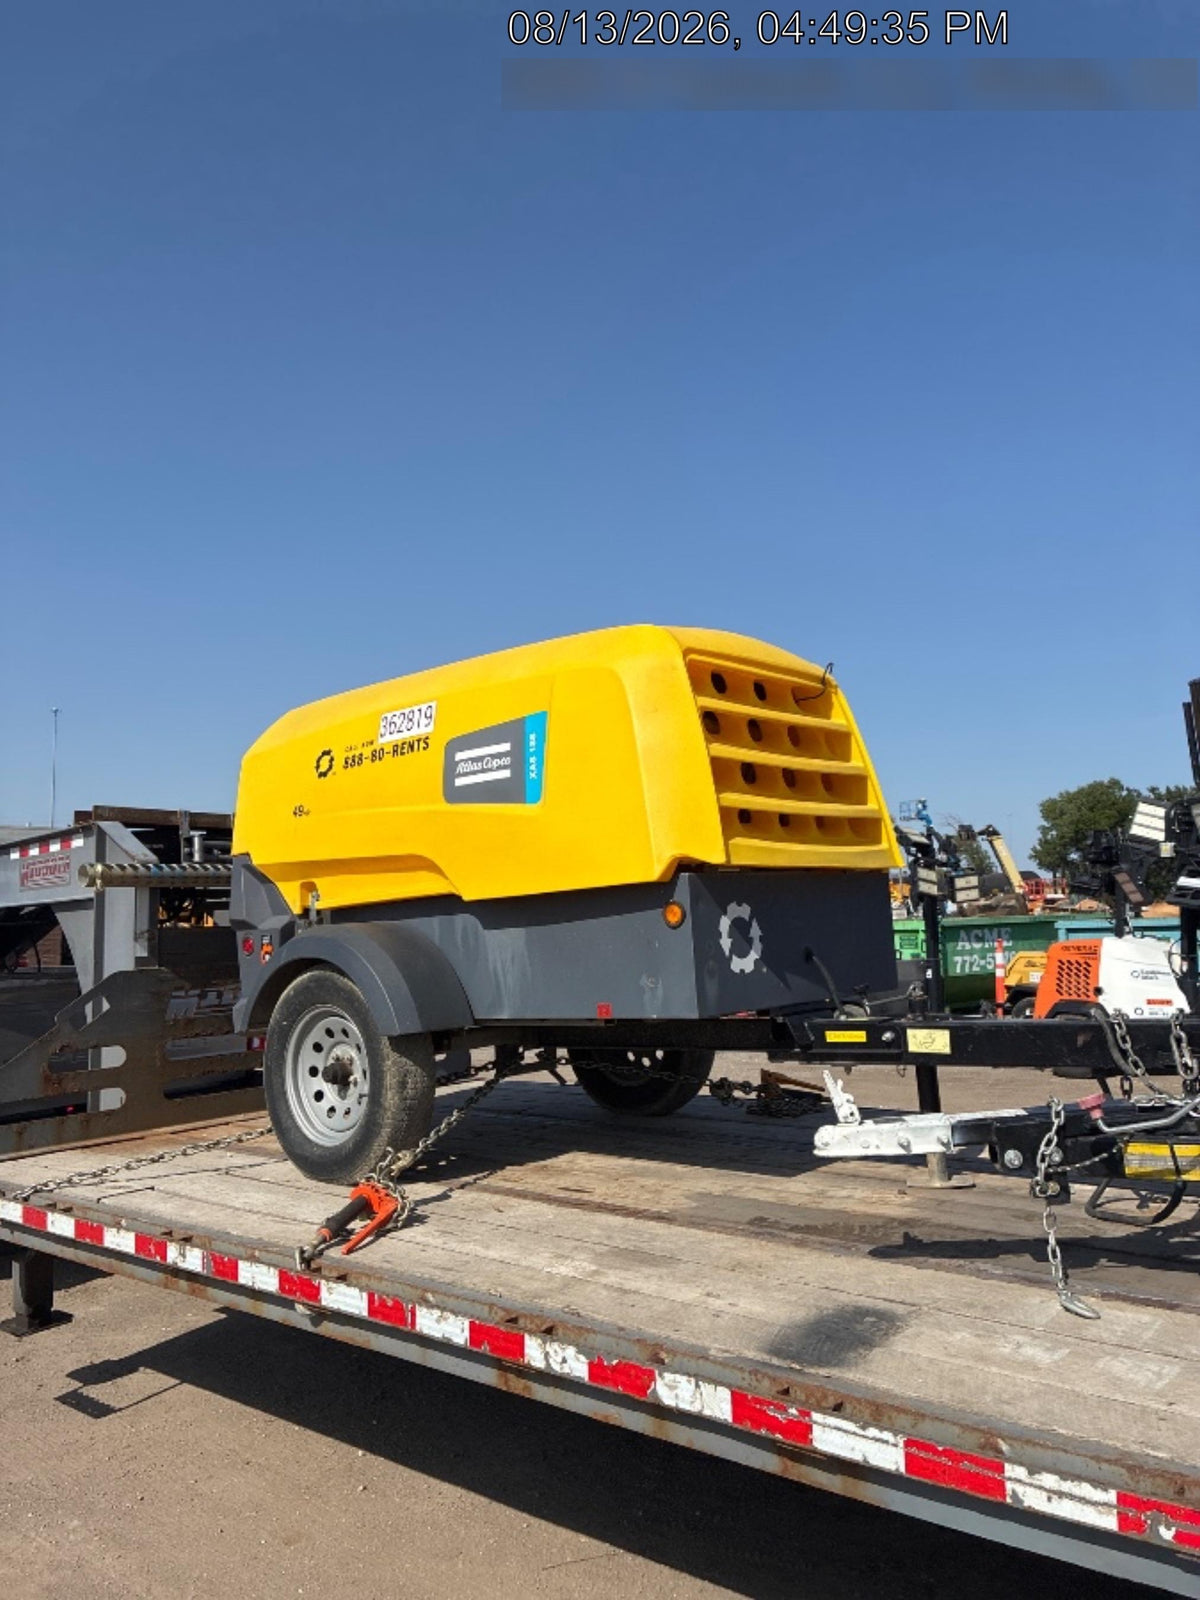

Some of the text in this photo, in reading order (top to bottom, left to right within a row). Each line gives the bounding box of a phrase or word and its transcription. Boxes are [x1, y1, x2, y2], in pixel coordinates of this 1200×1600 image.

[380, 705, 433, 738] 362819
[343, 736, 430, 770] 888-80-RENTS
[456, 760, 482, 774] Atlas
[956, 928, 1013, 950] ACME
